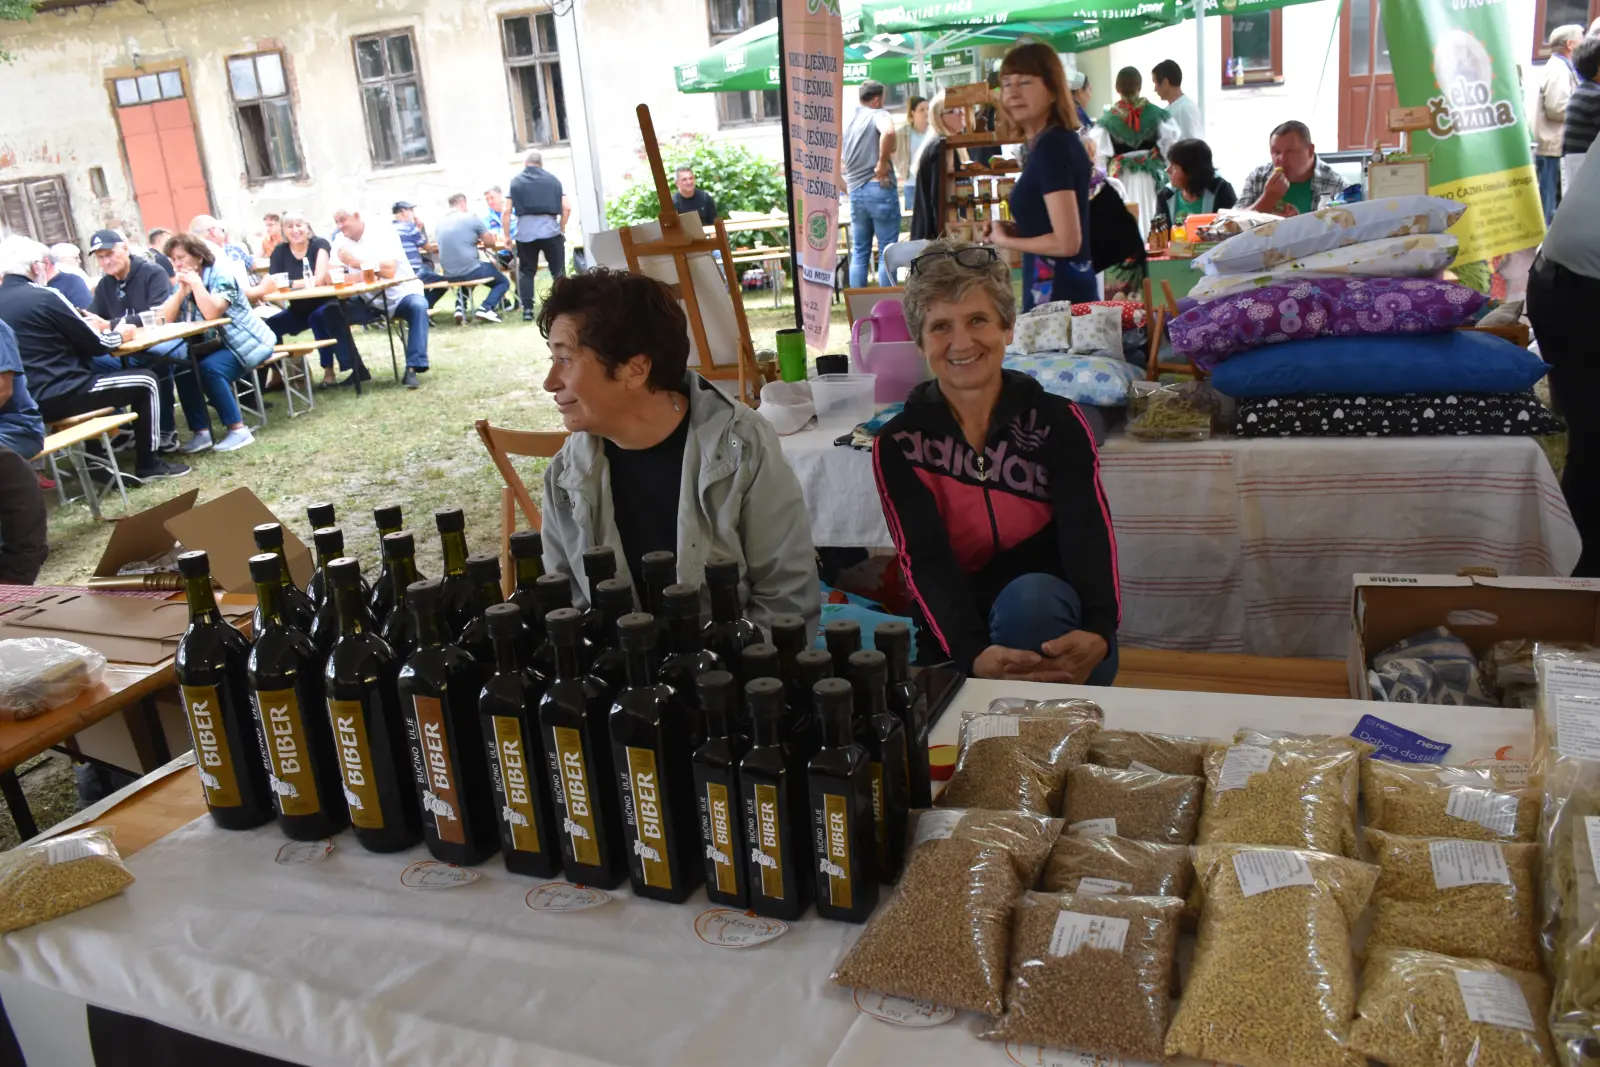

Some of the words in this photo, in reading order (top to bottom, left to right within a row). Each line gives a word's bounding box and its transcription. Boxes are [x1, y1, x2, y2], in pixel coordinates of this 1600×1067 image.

[1451, 78, 1489, 106] eko
[1429, 97, 1515, 138] Čazma
[891, 431, 1053, 499] adidas
[250, 694, 260, 720] ULJE
[406, 717, 416, 740] ULJE
[193, 700, 222, 767] BIBER
[270, 704, 300, 774] BIBER
[337, 716, 365, 785] BIBER
[425, 722, 450, 789] BIBER
[488, 741, 496, 759] ULJE
[1360, 731, 1398, 753] Dobro
[1416, 740, 1445, 751] nexi
[412, 746, 425, 784] BUČINO
[503, 740, 528, 804] BIBER
[549, 751, 557, 770] ULJE
[620, 772, 629, 791] ULJE
[564, 752, 588, 817] BIBER
[637, 773, 661, 839] BIBER
[713, 801, 729, 845] BIBER
[761, 802, 777, 847] BIBER
[831, 812, 846, 858] BIBER
